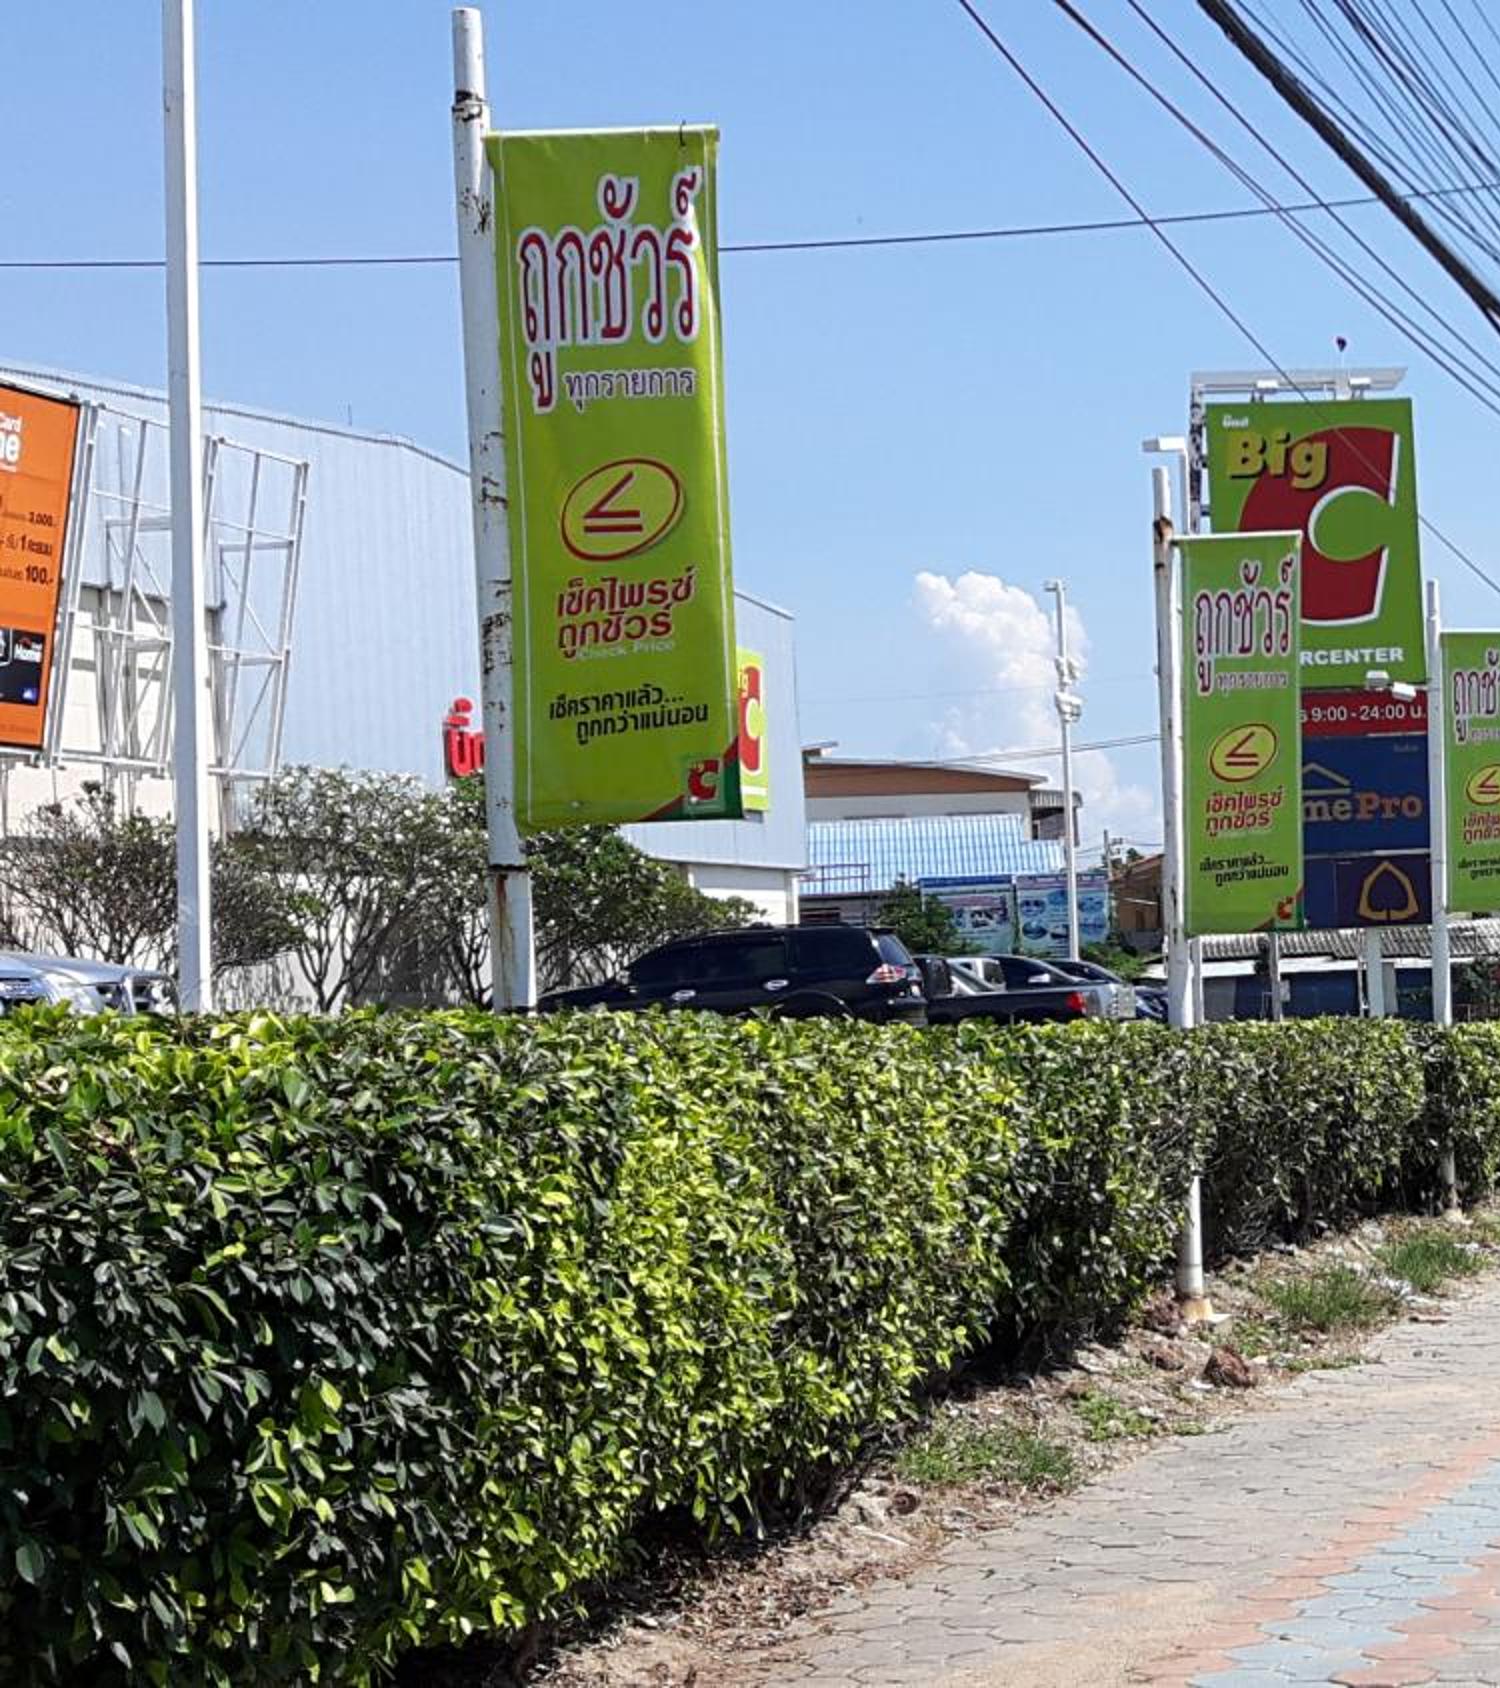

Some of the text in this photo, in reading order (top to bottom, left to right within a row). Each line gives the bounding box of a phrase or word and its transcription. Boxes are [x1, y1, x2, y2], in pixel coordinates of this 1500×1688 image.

[519, 168, 701, 412] ถูกชัวร์
[564, 366, 698, 411] ทุกรายการ
[1227, 431, 1330, 489] Big
[1238, 425, 1400, 627] C
[1194, 555, 1294, 696] ถูกชัวร์
[1299, 646, 1404, 667] RCENTER
[574, 702, 709, 746] ถูกกว่าแน่นอน
[1311, 705, 1347, 722] 9:00
[1359, 704, 1406, 721] 24:00
[1302, 792, 1424, 822] mePro
